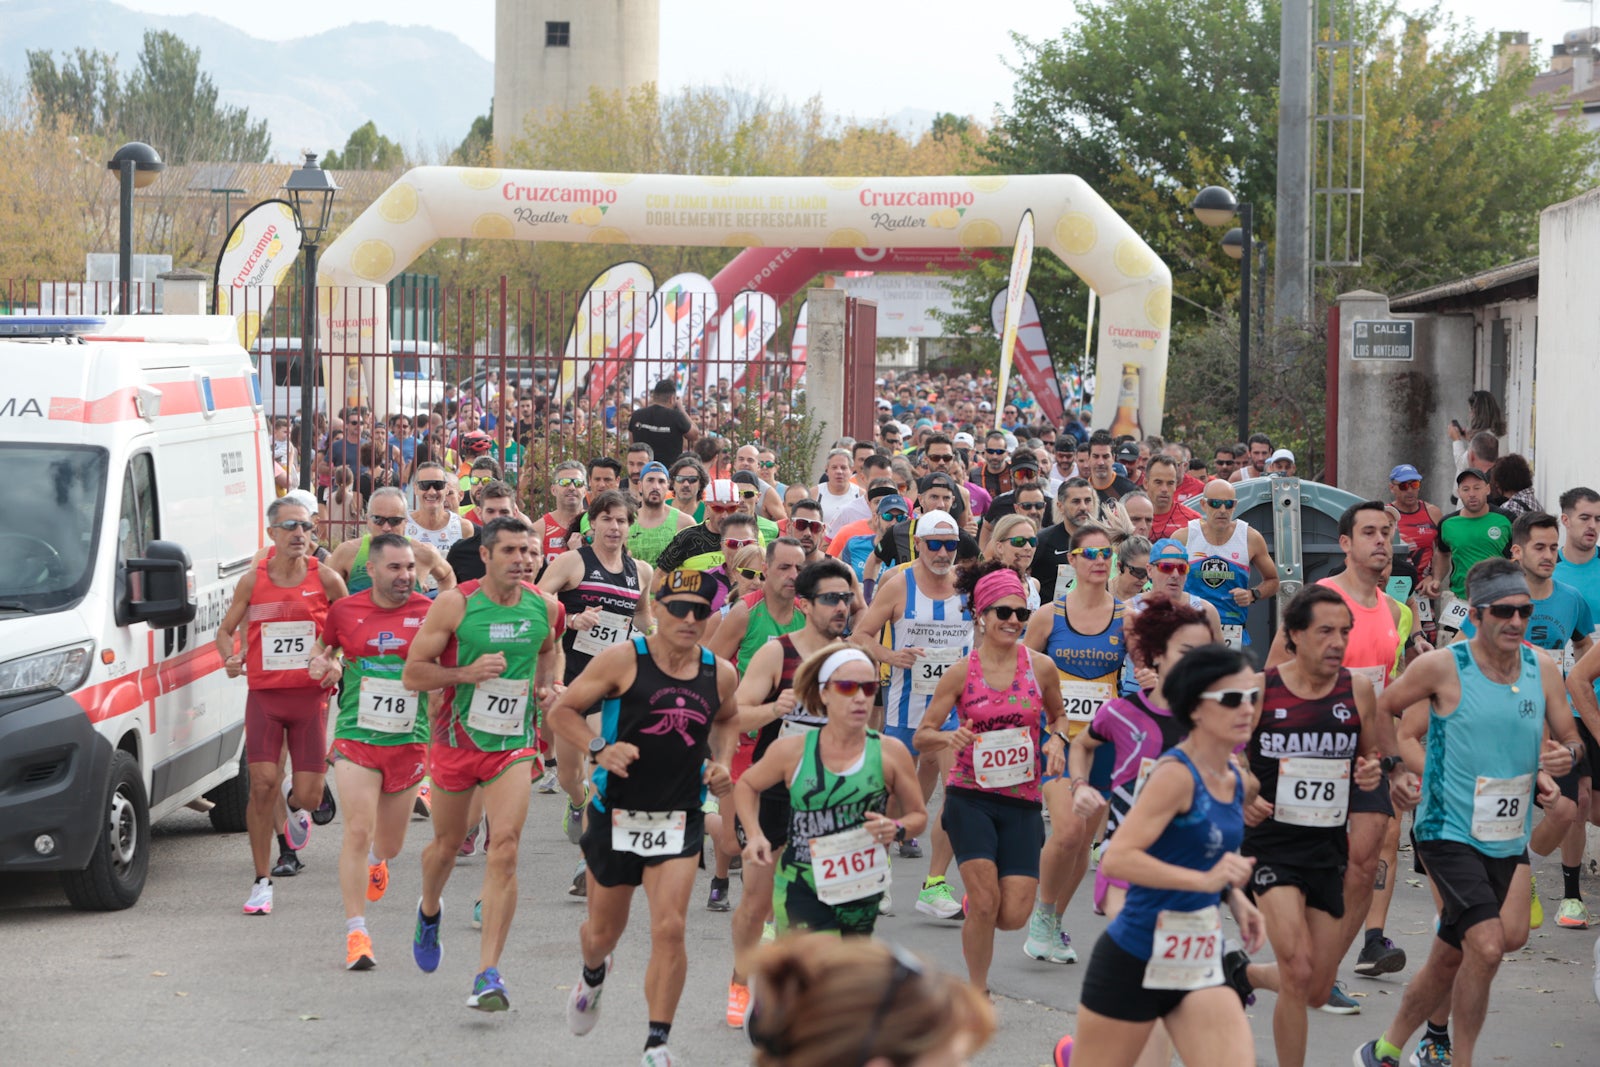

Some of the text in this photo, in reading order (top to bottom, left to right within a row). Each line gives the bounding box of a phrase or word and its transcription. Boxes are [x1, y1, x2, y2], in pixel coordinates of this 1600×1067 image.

[503, 182, 617, 206] Cruzcampo
[646, 194, 828, 210] CON ZUMO NATURAL DE LIMÓN
[860, 189, 975, 208] Cruzcampo
[513, 207, 569, 226] Radler
[646, 211, 828, 228] DOBLEMENTE REFRESCANTE
[870, 213, 926, 231] Radler
[232, 224, 277, 289] Cruzcampo
[247, 258, 272, 288] Radler
[1108, 325, 1161, 340] Cruzcampo
[1373, 324, 1407, 334] CALLE
[589, 625, 618, 643] 551
[907, 627, 935, 637] PAZITO
[942, 629, 968, 638] PAZITO
[928, 638, 949, 646] Motril
[273, 638, 305, 653] 275
[1055, 647, 1119, 662] agustinos
[373, 695, 406, 714] 718
[487, 695, 518, 715] 707
[1259, 731, 1358, 753] GRANADA
[981, 746, 1028, 769] 2029
[1294, 780, 1336, 802] 678
[1496, 798, 1520, 818] 28
[792, 809, 835, 838] TEAM
[628, 831, 668, 850] 784
[821, 847, 876, 880] 2167
[1163, 934, 1217, 960] 2178
